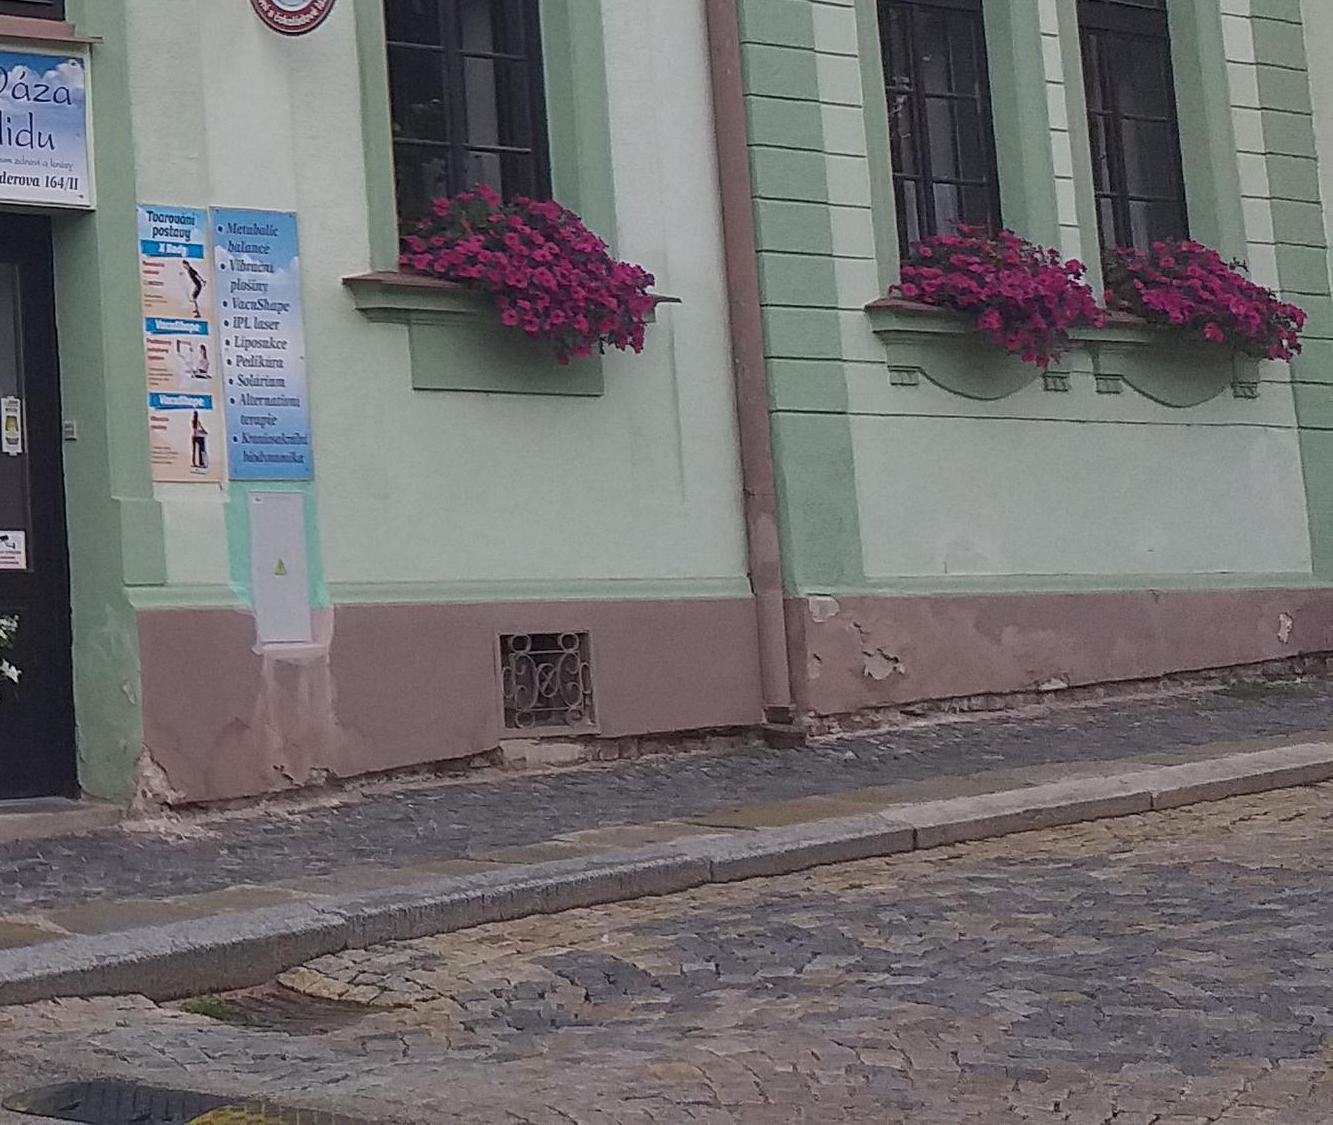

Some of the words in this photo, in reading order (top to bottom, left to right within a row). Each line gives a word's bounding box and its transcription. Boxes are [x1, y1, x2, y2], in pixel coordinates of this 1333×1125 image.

[44, 175, 79, 191] 164/II
[152, 225, 191, 242] postavy
[226, 222, 279, 237] Metabolic
[227, 240, 271, 255] balance
[230, 278, 269, 294] plošiny
[232, 297, 290, 314] VacuShape
[233, 316, 251, 329] IPL
[254, 316, 281, 330] laser
[234, 335, 288, 351] Liposukce
[240, 413, 278, 428] terapie
